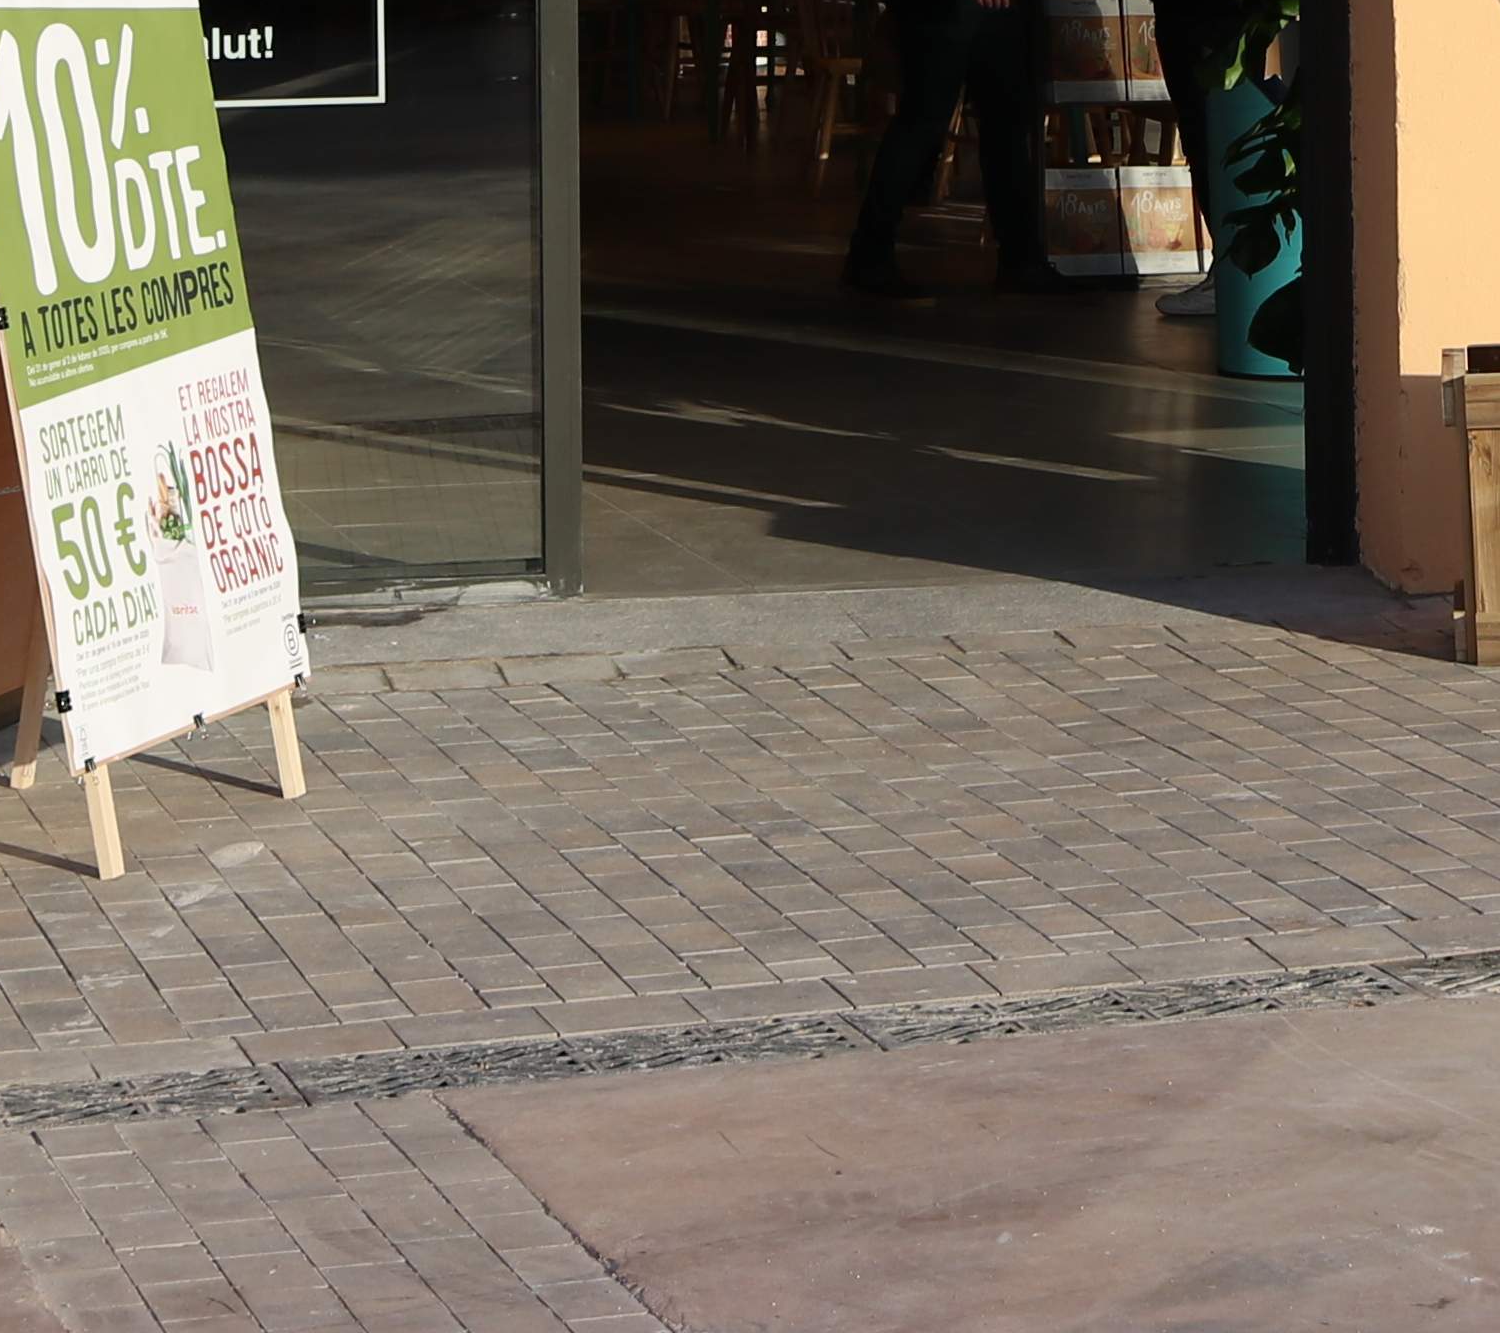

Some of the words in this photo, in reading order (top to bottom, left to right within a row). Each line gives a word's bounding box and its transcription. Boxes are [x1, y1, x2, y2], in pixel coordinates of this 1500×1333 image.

[114, 145, 227, 271] DTE.
[20, 310, 36, 358] A
[37, 295, 99, 353] TOTES
[100, 285, 138, 336] LES
[140, 261, 235, 326] COMPRES
[178, 384, 193, 412] ET
[197, 367, 249, 407] REGALEM
[39, 404, 125, 464] SORTEGEM
[182, 414, 201, 447] LA
[203, 397, 256, 441] NOSTRA
[44, 466, 62, 501] UN
[65, 453, 108, 494] CARRO
[110, 446, 131, 481] DE
[189, 431, 264, 506] BOSSA
[51, 495, 113, 601] 50
[200, 505, 228, 551] DE
[72, 595, 120, 646] CADA
